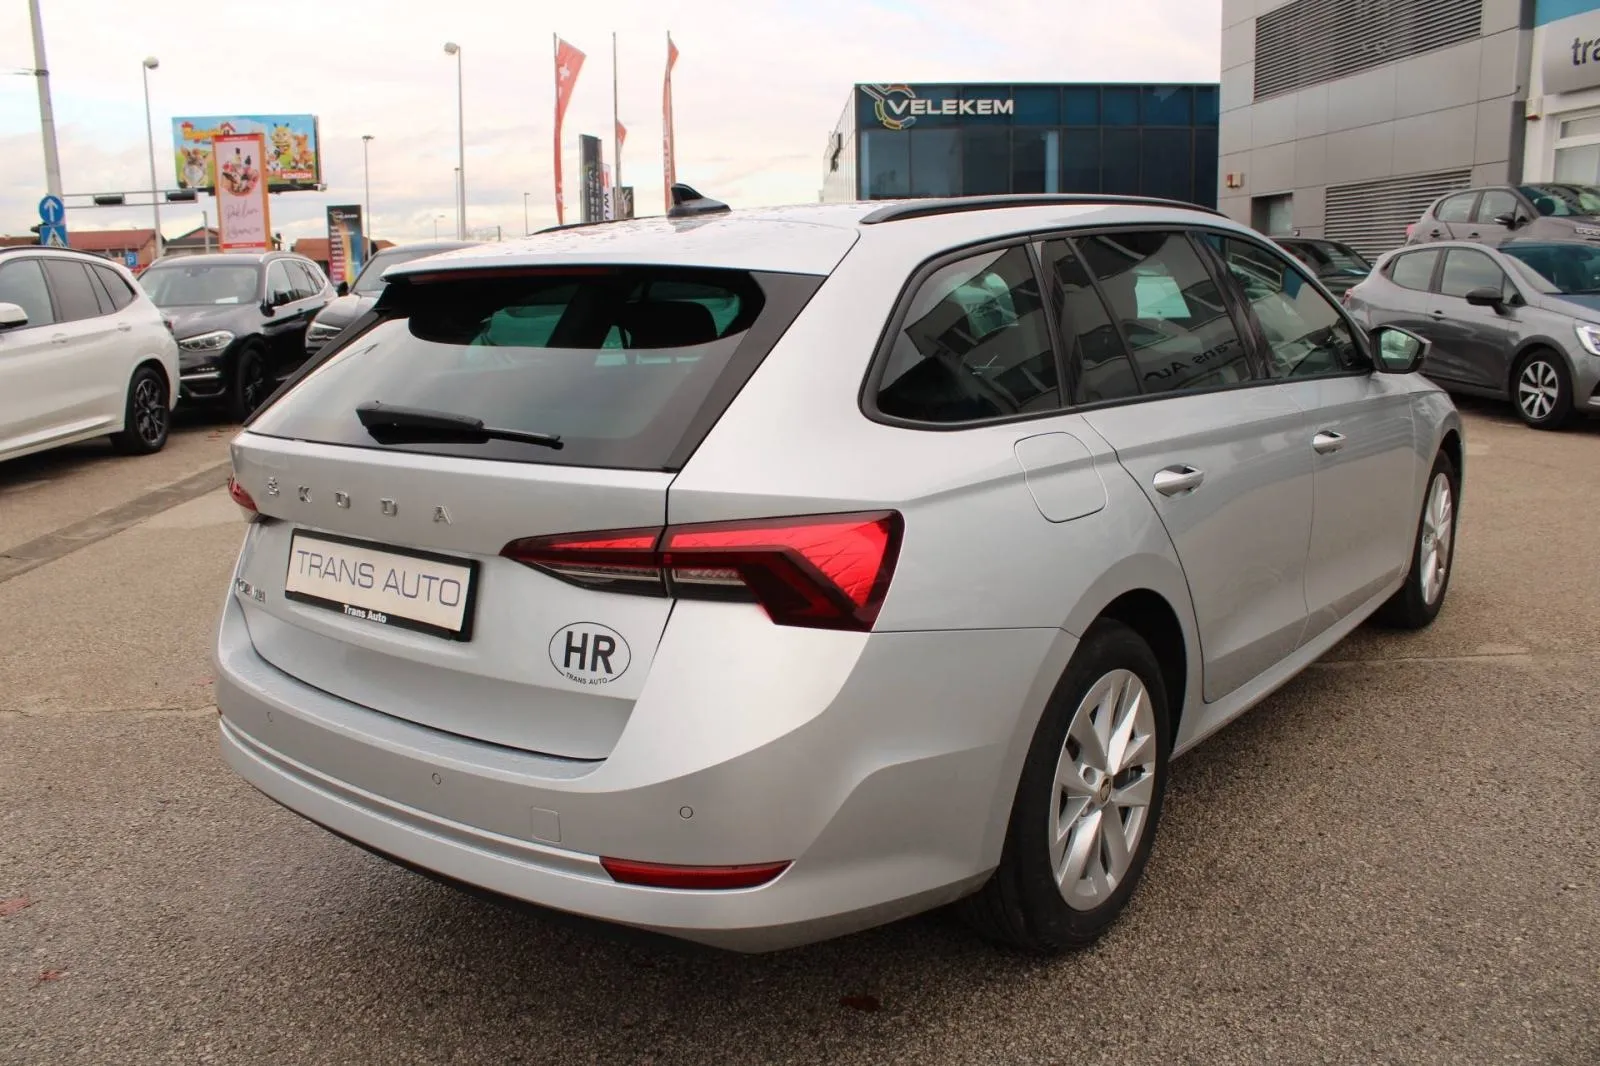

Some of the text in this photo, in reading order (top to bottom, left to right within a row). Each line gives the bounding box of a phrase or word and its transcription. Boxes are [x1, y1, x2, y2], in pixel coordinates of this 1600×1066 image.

[886, 99, 1010, 115] VELEKEM
[297, 550, 461, 607] TRANS AUTO
[343, 604, 387, 624] Trans Auto
[564, 631, 615, 674] HR
[566, 672, 608, 686] TRANS AUTO
